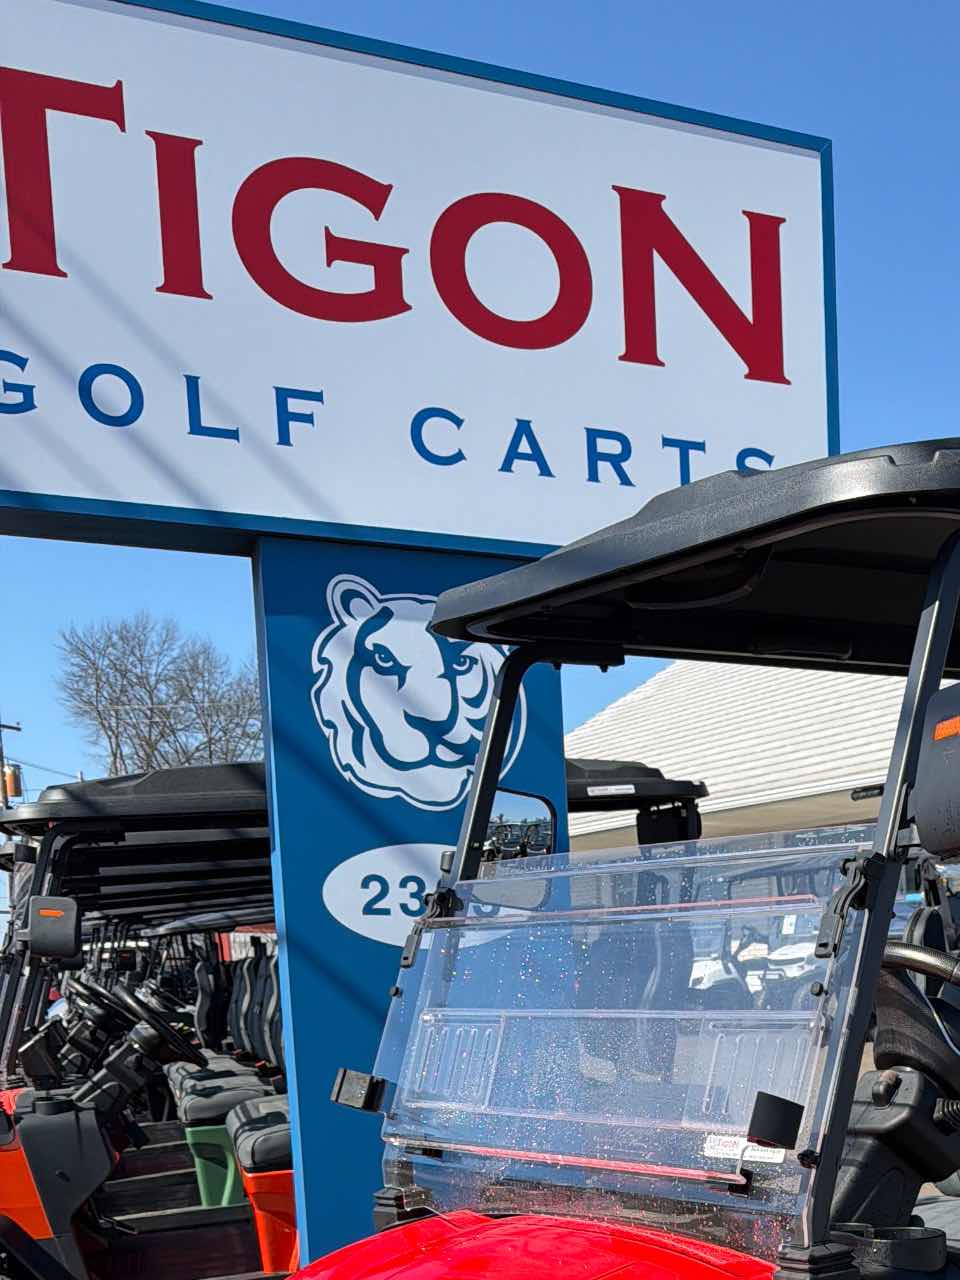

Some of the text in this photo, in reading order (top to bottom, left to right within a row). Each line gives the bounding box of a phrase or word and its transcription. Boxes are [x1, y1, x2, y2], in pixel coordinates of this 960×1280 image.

[0, 66, 792, 386] TIGON
[0, 349, 325, 447] GOLF
[361, 873, 501, 918] 23
